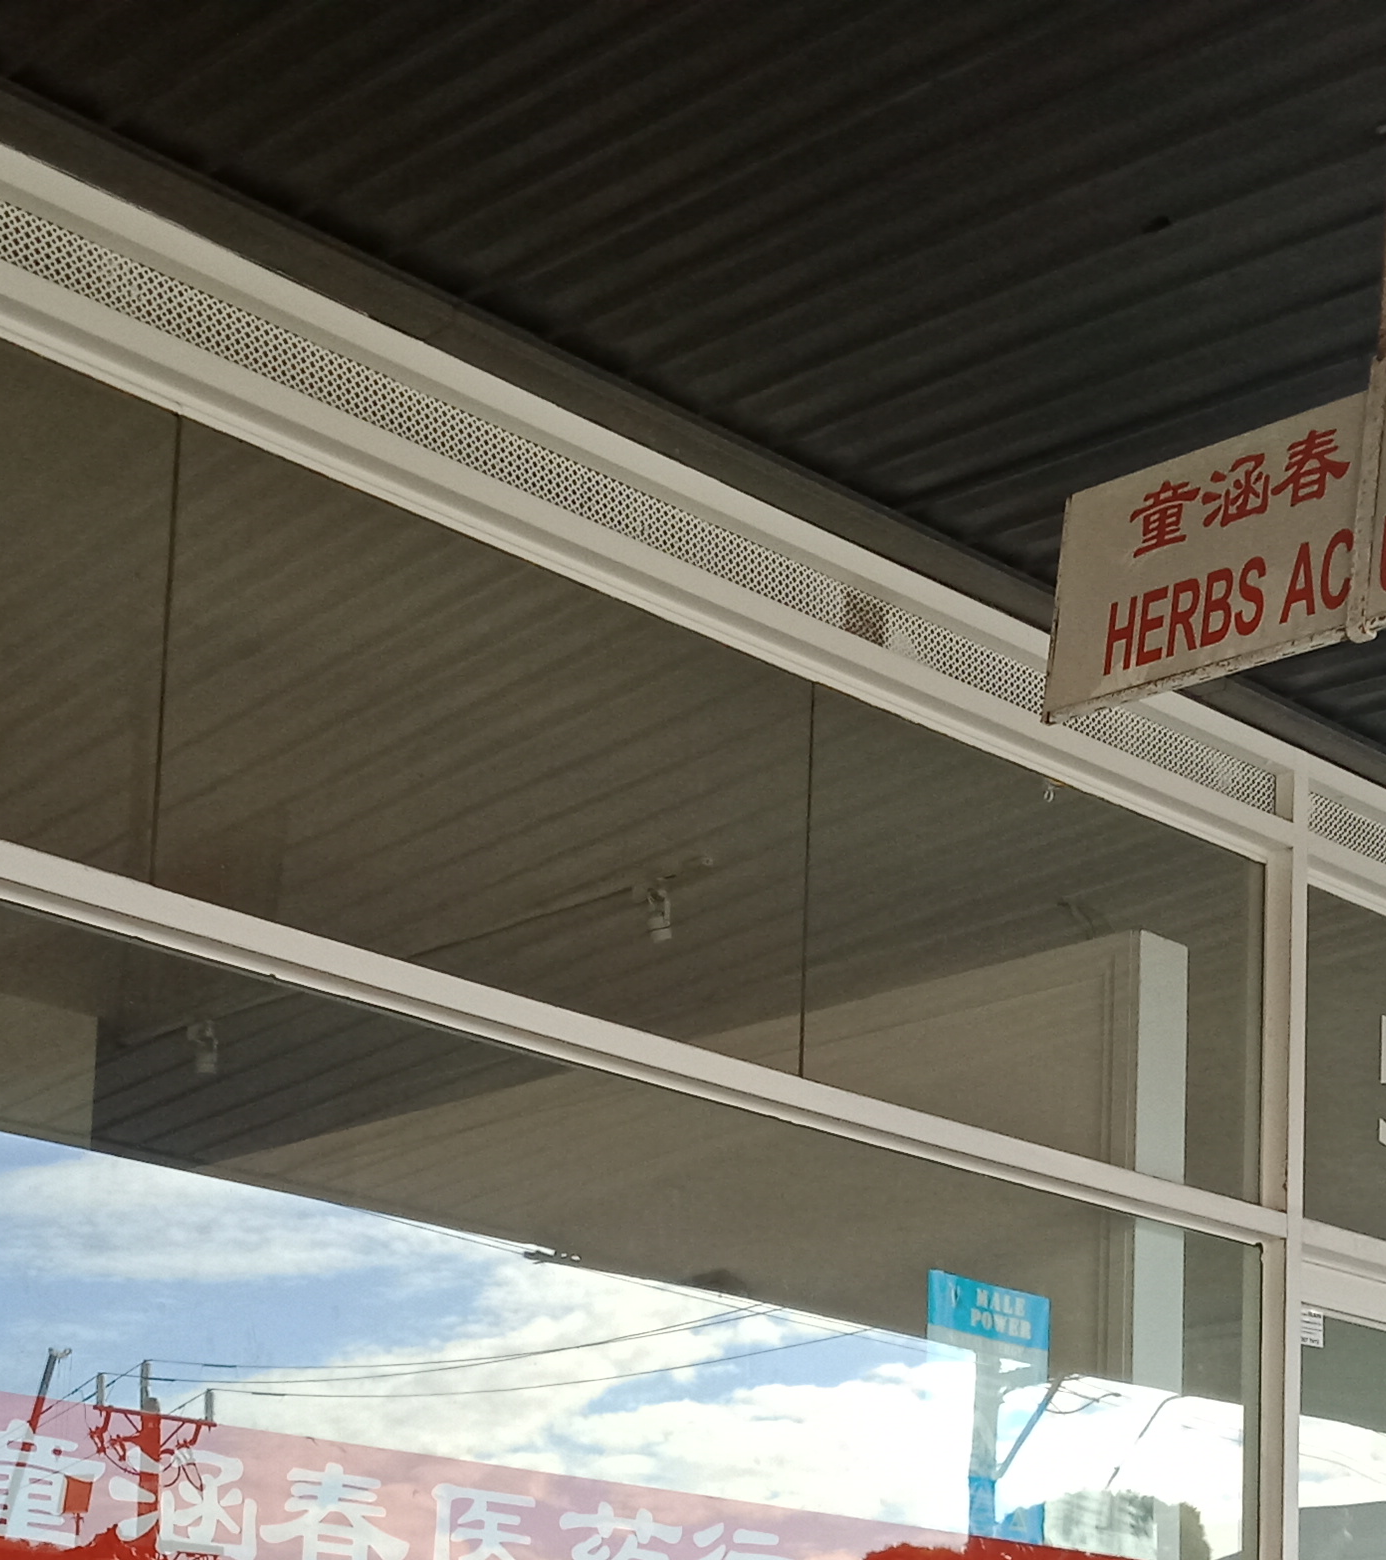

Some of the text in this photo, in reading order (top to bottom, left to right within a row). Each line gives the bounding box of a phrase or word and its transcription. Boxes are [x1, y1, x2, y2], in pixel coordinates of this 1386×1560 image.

[1130, 429, 1351, 558] 童涵春
[1103, 556, 1268, 676] HERBS
[969, 1307, 1033, 1341] POWER
[975, 1286, 1027, 1318] MALE
